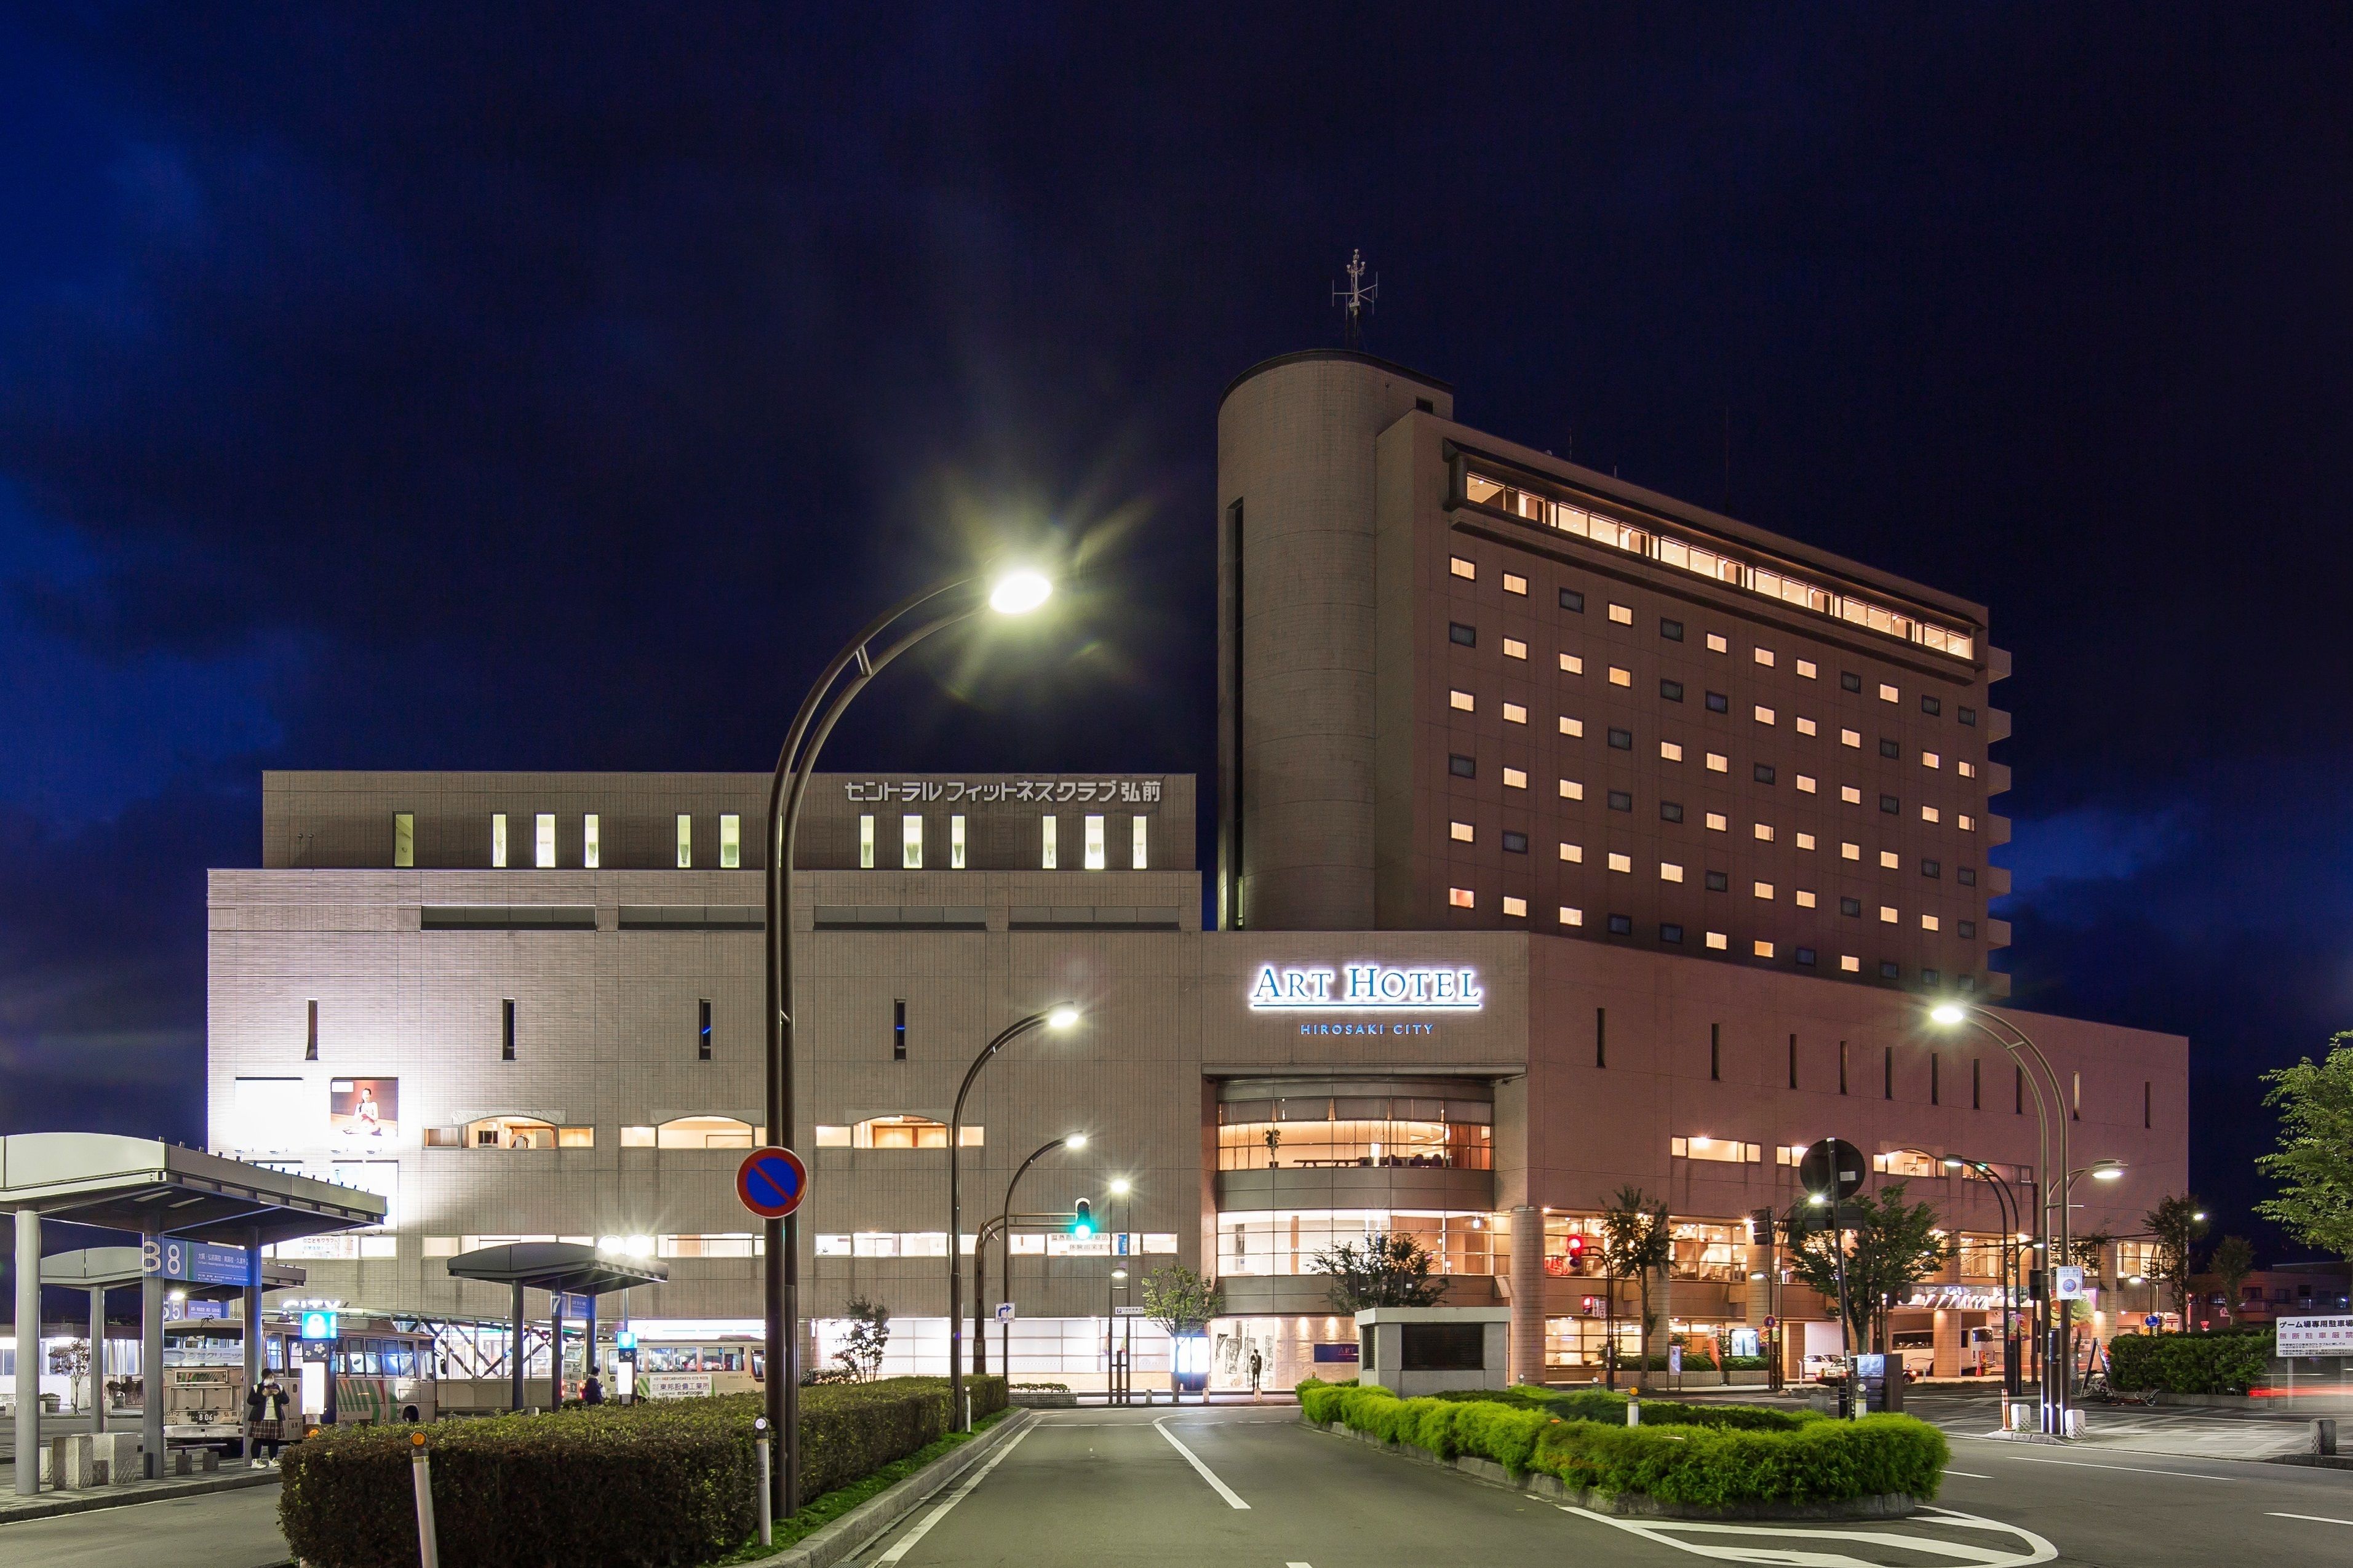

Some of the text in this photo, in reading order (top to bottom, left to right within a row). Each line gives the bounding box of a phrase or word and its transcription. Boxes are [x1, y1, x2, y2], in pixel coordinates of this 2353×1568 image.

[1252, 967, 1479, 998] ART HOTEL
[1300, 1024, 1435, 1035] HIROSAKI CITY
[143, 1241, 162, 1273] 8
[167, 1244, 181, 1275] 8
[172, 1301, 180, 1320] 5
[551, 1295, 561, 1313] 7
